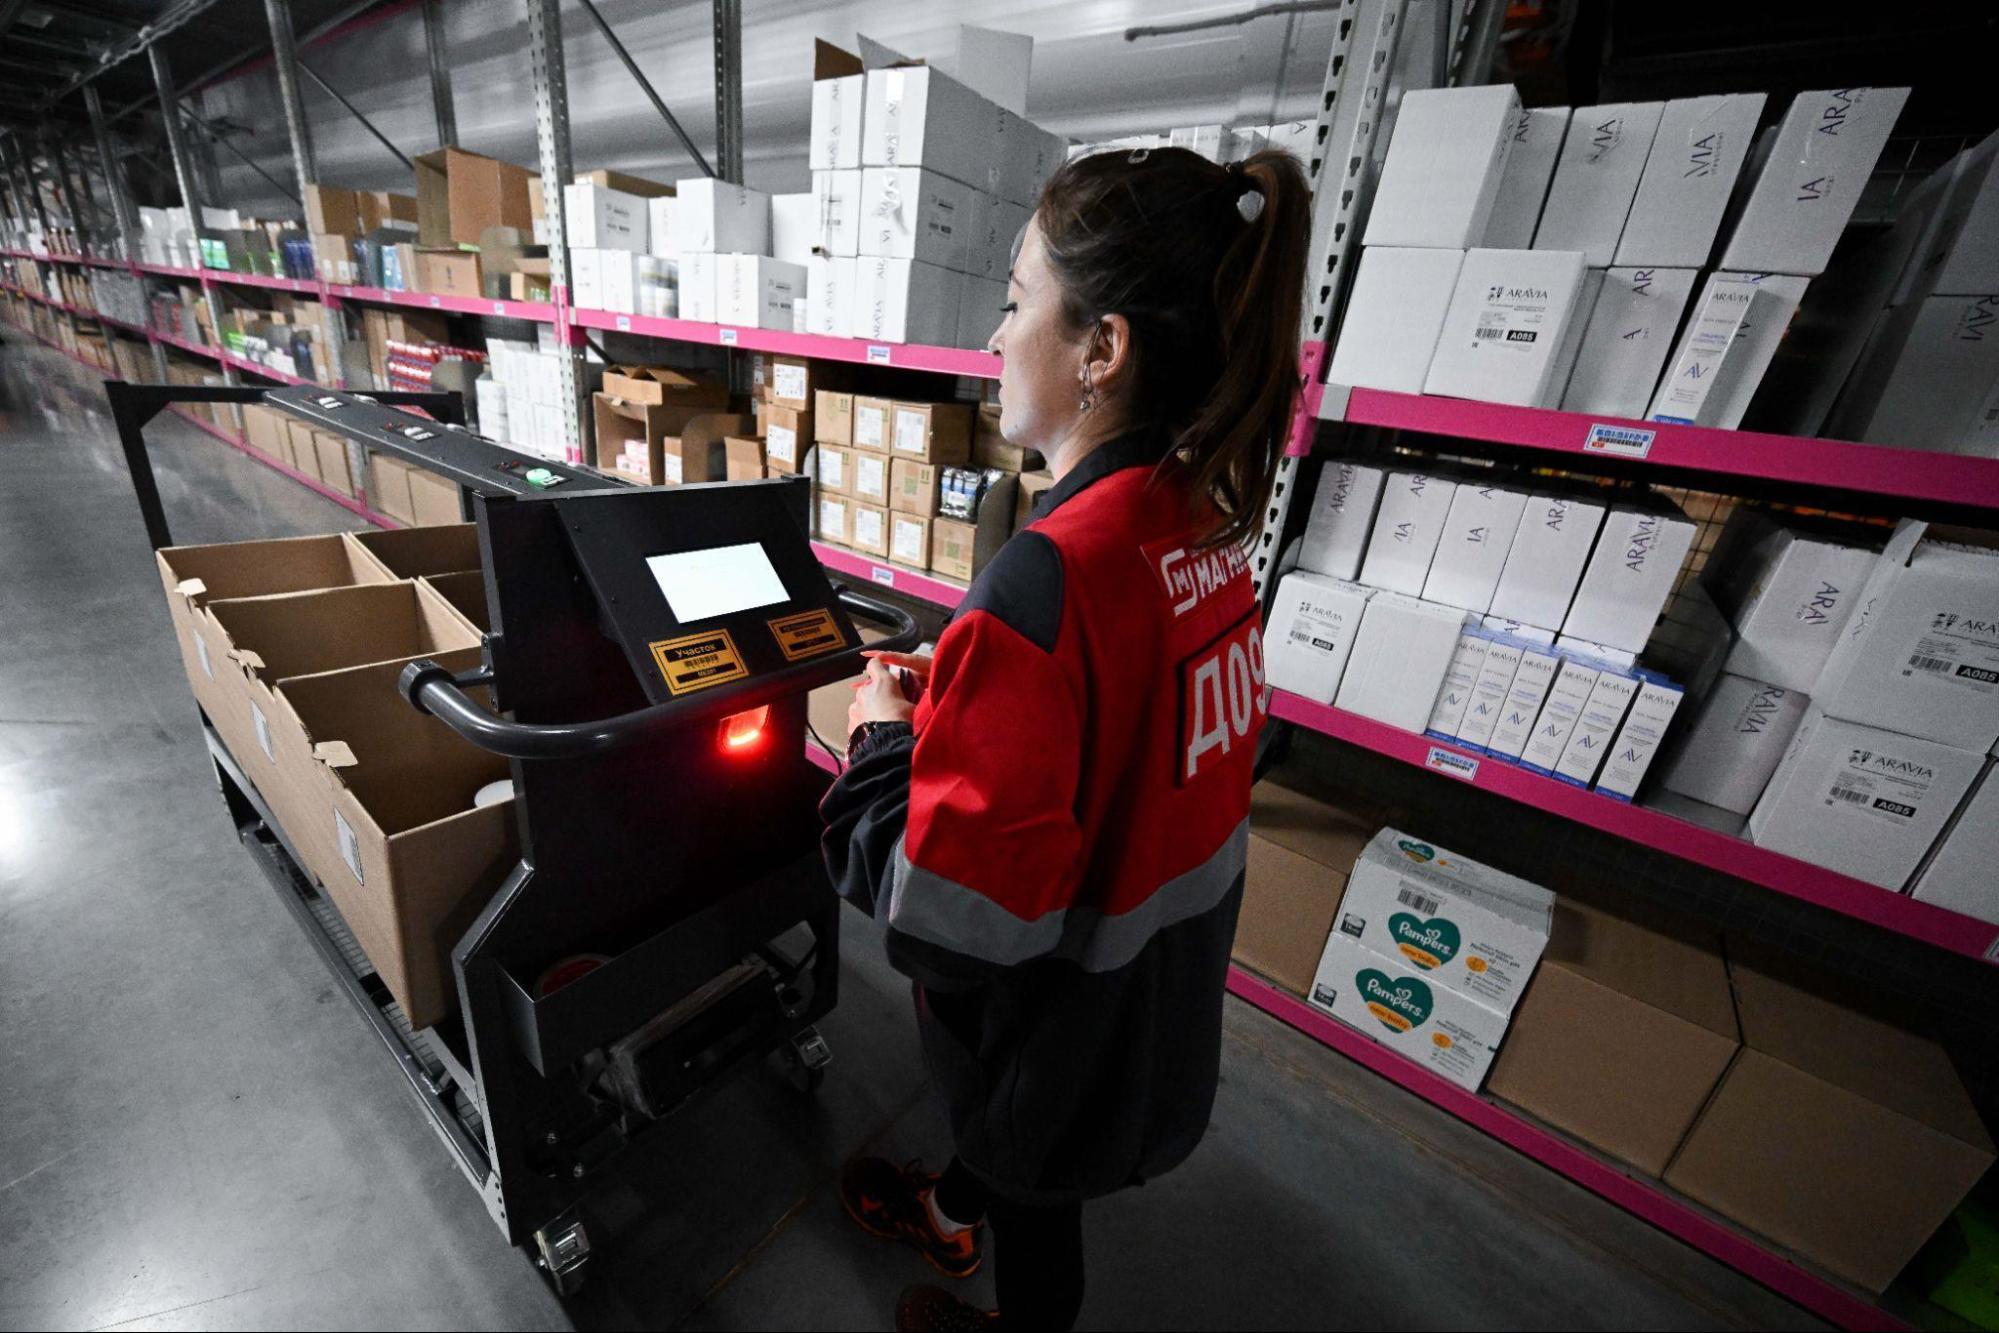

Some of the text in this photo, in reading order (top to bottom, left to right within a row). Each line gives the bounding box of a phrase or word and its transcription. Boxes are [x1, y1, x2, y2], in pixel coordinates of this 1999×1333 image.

[1506, 287, 1548, 300] ARAVIA
[1712, 292, 1749, 302] ARAVIA
[1510, 331, 1534, 341] A085
[1313, 607, 1343, 621] ARAVIA
[1960, 619, 1999, 633] ARA
[676, 643, 717, 659] Участок
[1491, 651, 1517, 663] ARAVIA
[1524, 659, 1552, 672] ARAVIA
[1562, 671, 1592, 685] ARAVIA
[1600, 681, 1630, 695] ARAVIA
[1642, 692, 1675, 706] ARAVIA
[1875, 755, 1933, 779] ARAVIA
[1877, 801, 1911, 816] A085
[1399, 921, 1452, 955] Pampers
[1366, 978, 1423, 1017] Pampers
